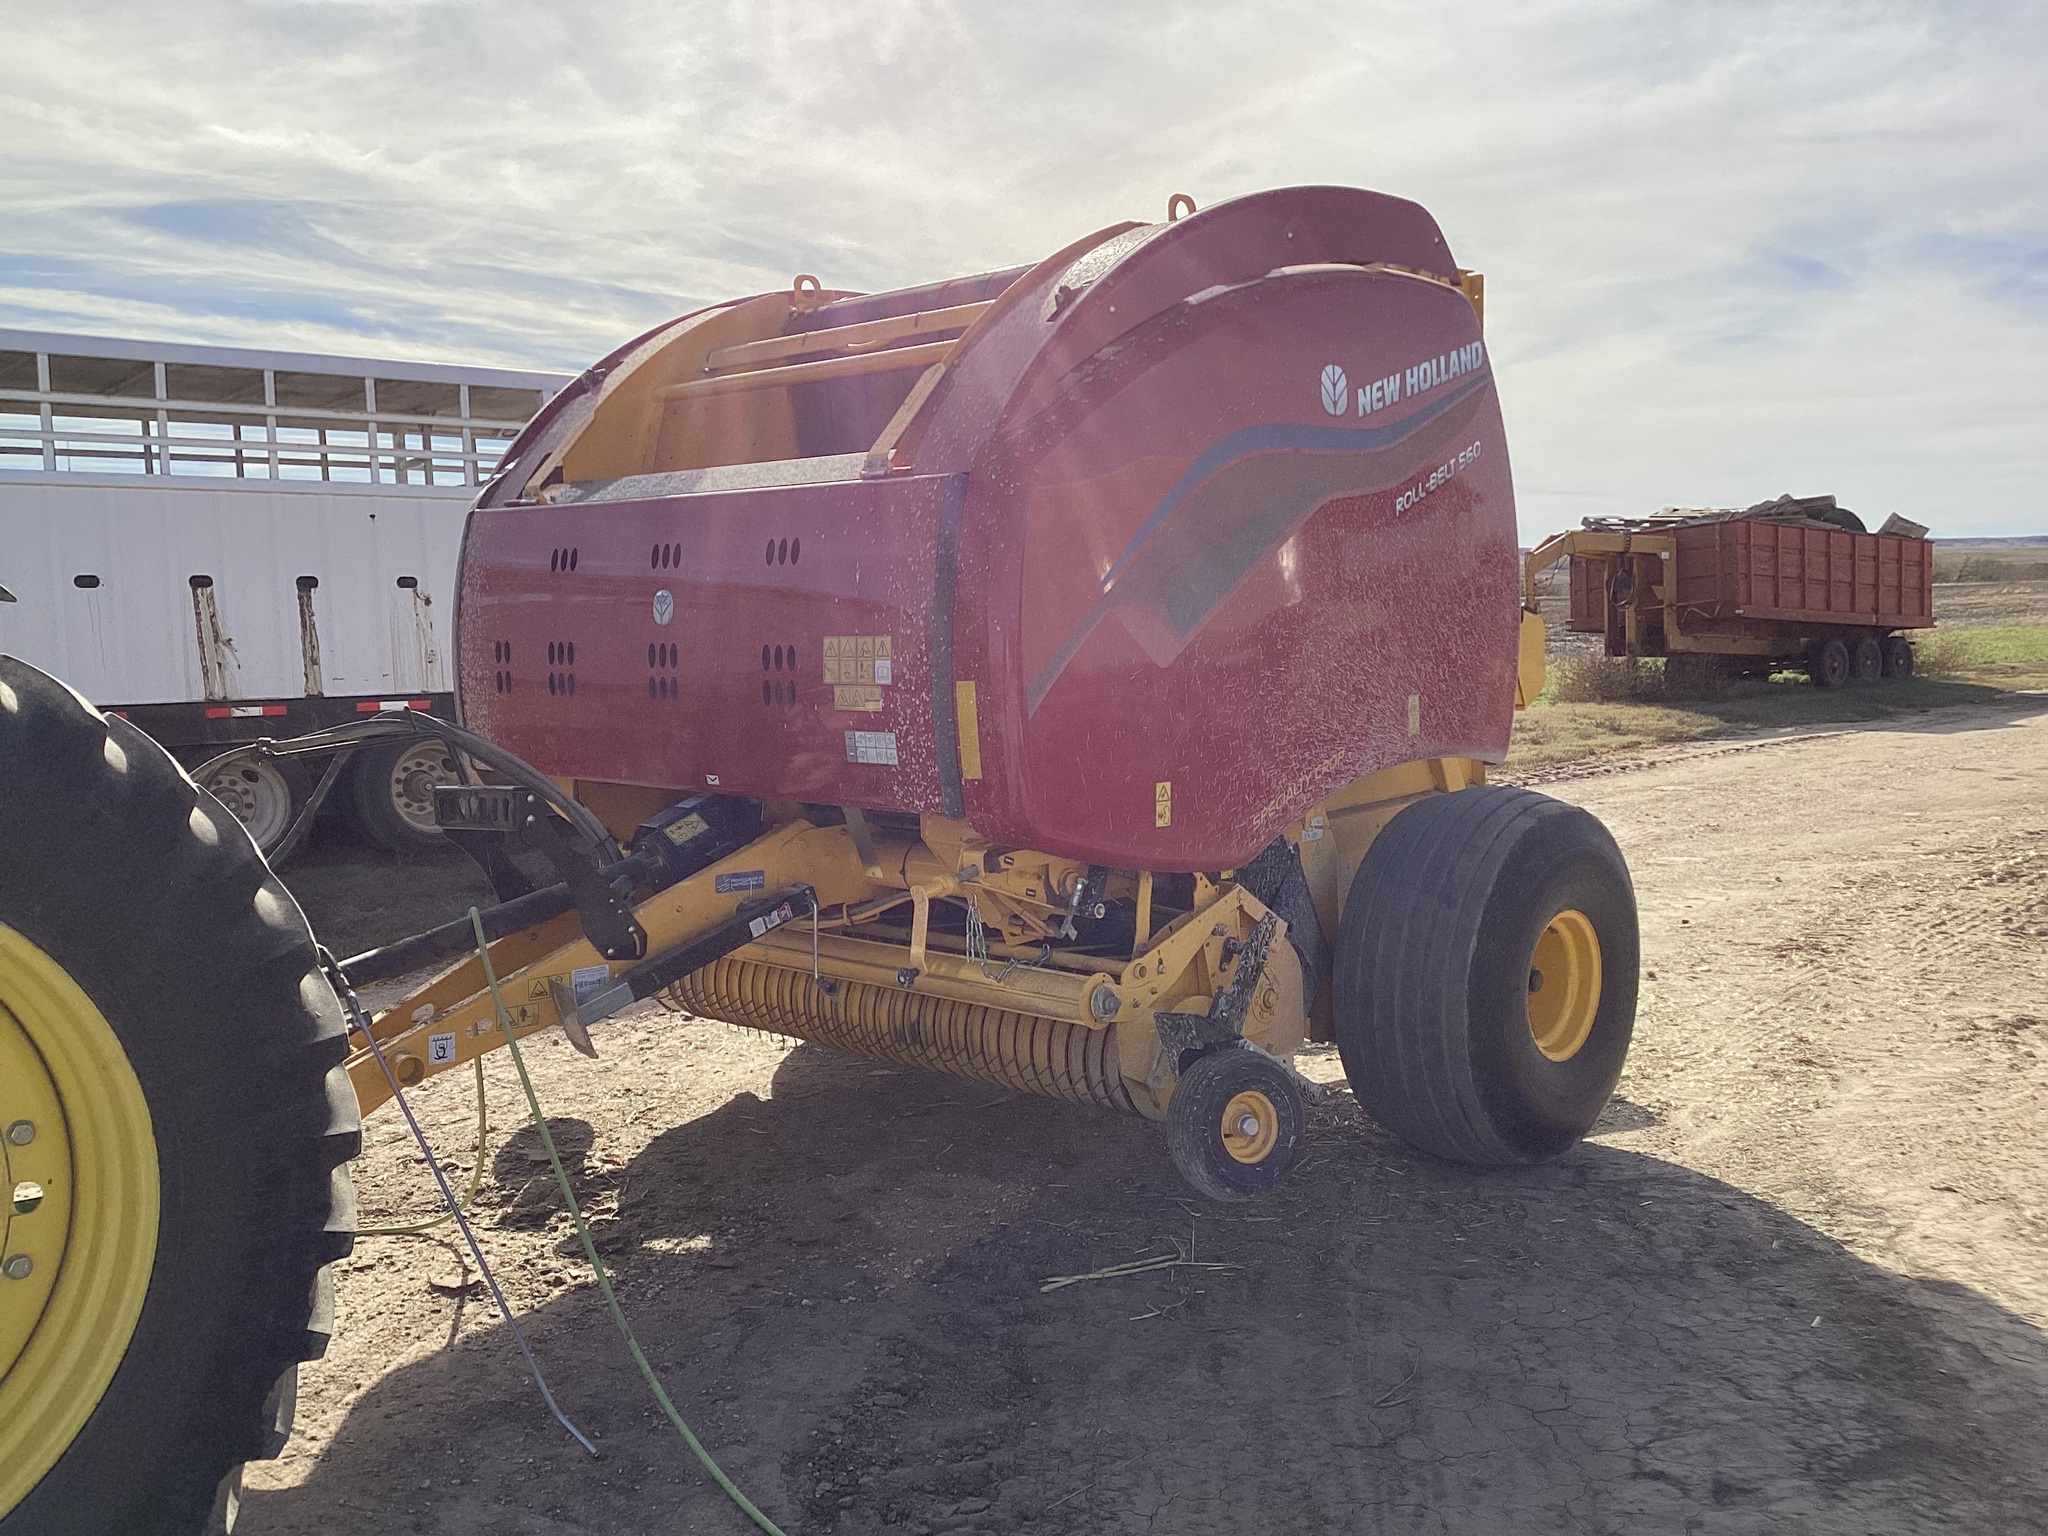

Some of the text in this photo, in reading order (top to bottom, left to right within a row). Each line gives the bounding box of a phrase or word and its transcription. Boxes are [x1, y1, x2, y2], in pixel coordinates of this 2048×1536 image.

[1357, 341, 1483, 417] NEW HOLLAND
[1396, 441, 1481, 516] ROLL-BELT 560
[1252, 750, 1345, 832] SPECIALTY CROP
